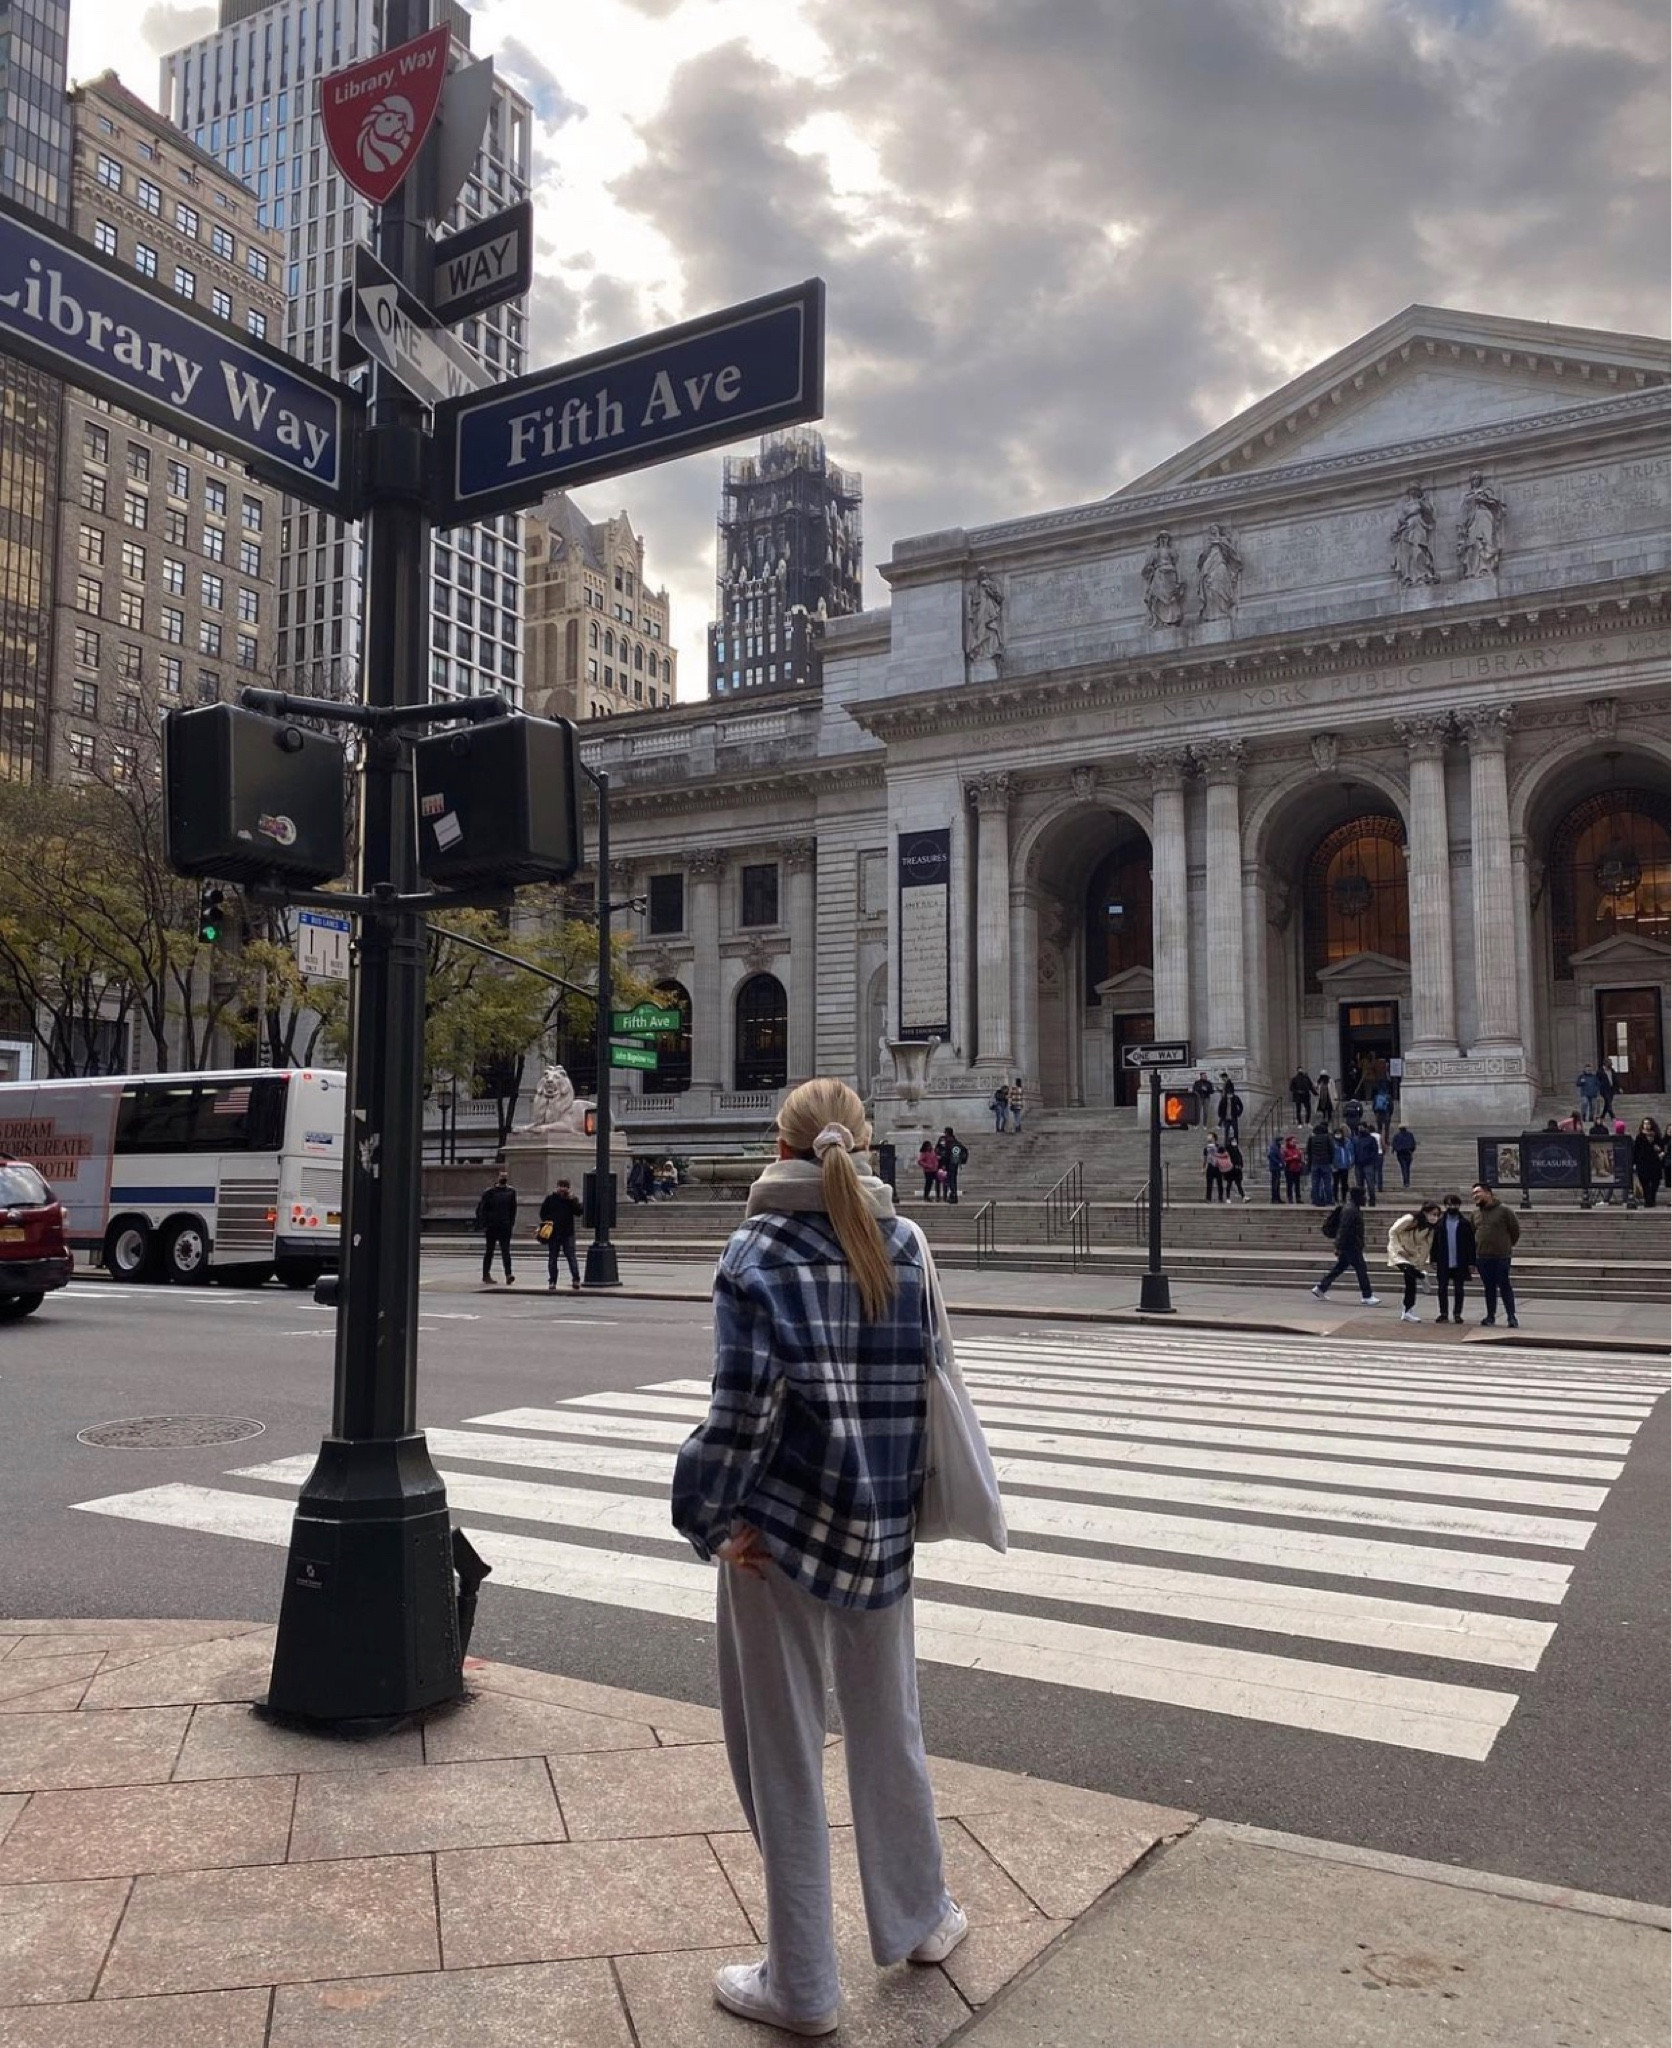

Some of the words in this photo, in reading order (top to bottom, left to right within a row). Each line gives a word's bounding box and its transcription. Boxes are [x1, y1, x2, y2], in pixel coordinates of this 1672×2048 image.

[335, 66, 395, 105] Library
[399, 46, 437, 76] Way
[449, 238, 511, 296] WAY
[377, 296, 422, 367] ONE
[0, 258, 203, 405] ibrary
[219, 359, 330, 469] Way
[506, 387, 625, 467] Fifth
[640, 365, 742, 427] Ave
[1512, 483, 1541, 498] THE
[1554, 472, 1609, 491] TILDEN
[1100, 706, 1145, 729] THE
[1163, 697, 1223, 720] NEW
[1243, 686, 1312, 708] YORK
[1330, 667, 1423, 695] PUBLIC
[1450, 648, 1562, 679] LIBRARY
[902, 852, 947, 866] TREASURES
[623, 1016, 647, 1029] Fifth
[650, 1016, 670, 1028] Ave
[1132, 1051, 1150, 1060] ONE
[1158, 1050, 1178, 1059] WAY
[4, 1122, 52, 1138] DREAM
[34, 1138, 90, 1156] CREATE.
[36, 1160, 76, 1177] BOTH.
[1531, 1159, 1578, 1168] TREASURES
